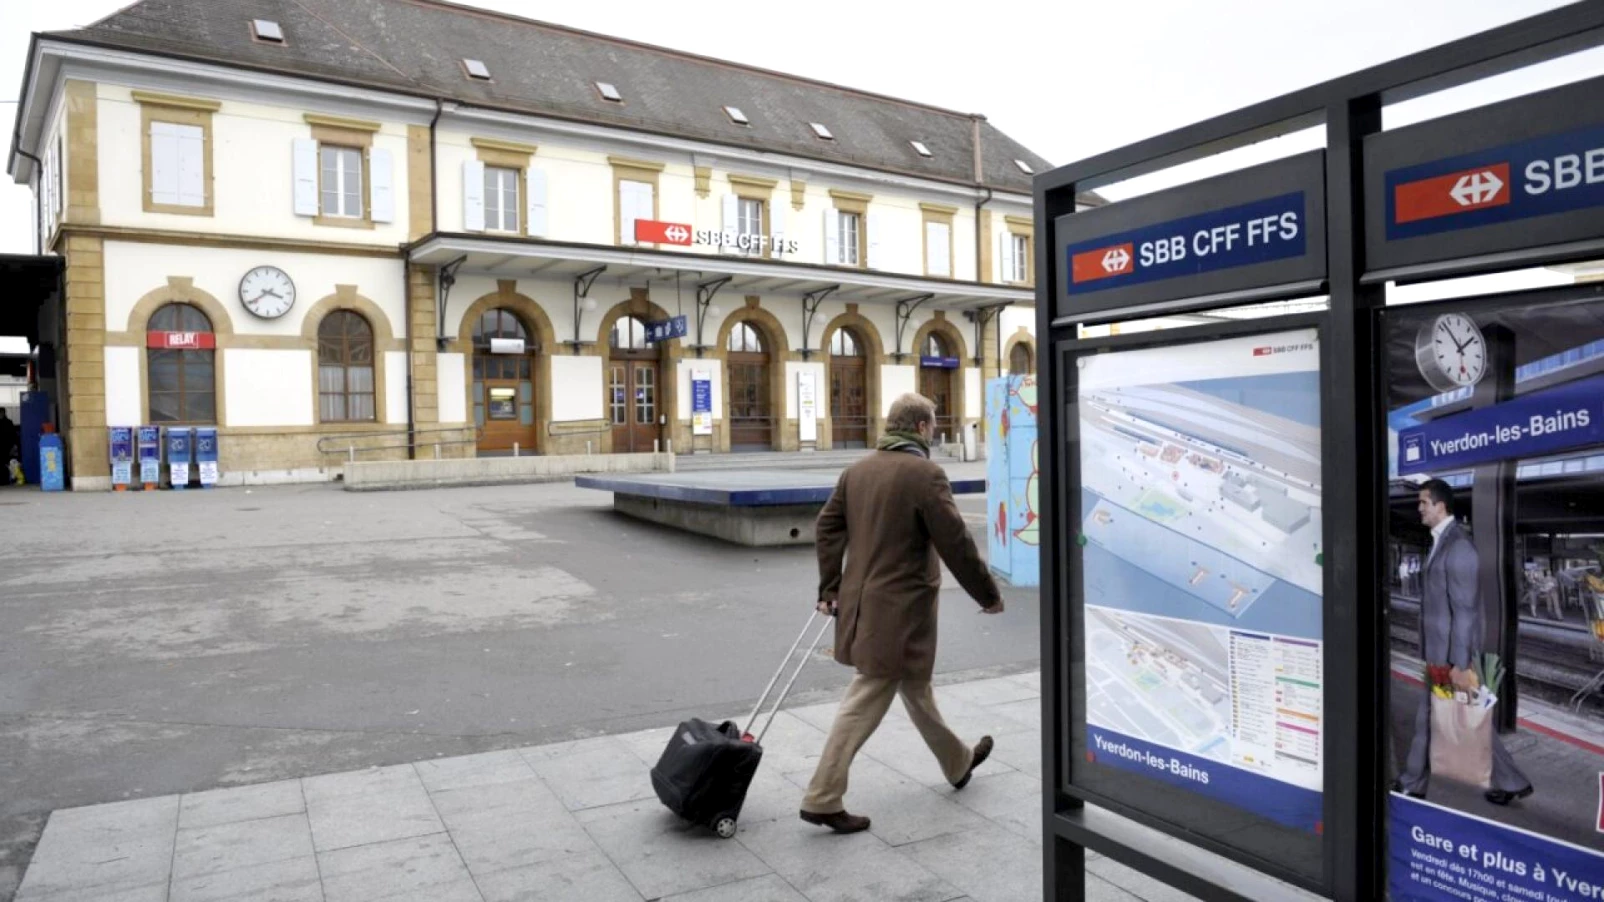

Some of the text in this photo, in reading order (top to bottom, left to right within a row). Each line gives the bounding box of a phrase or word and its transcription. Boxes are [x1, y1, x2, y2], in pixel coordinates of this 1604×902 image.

[696, 230, 731, 247] SBB
[736, 233, 769, 250] CFF
[1139, 211, 1299, 267] SBB CFF FFS
[168, 332, 195, 346] RELAY
[1430, 408, 1590, 457] Yverdon-les-Bains
[1093, 733, 1209, 785] Yverdon-les-Bains
[1411, 825, 1604, 901] Gare et plus à Yver
[1411, 848, 1448, 868] Vendredi
[1468, 868, 1495, 884] 17h00
[1496, 880, 1506, 889] et
[1508, 883, 1544, 901] samedi
[1433, 880, 1472, 901] concours
[1458, 877, 1500, 900] Musique,
